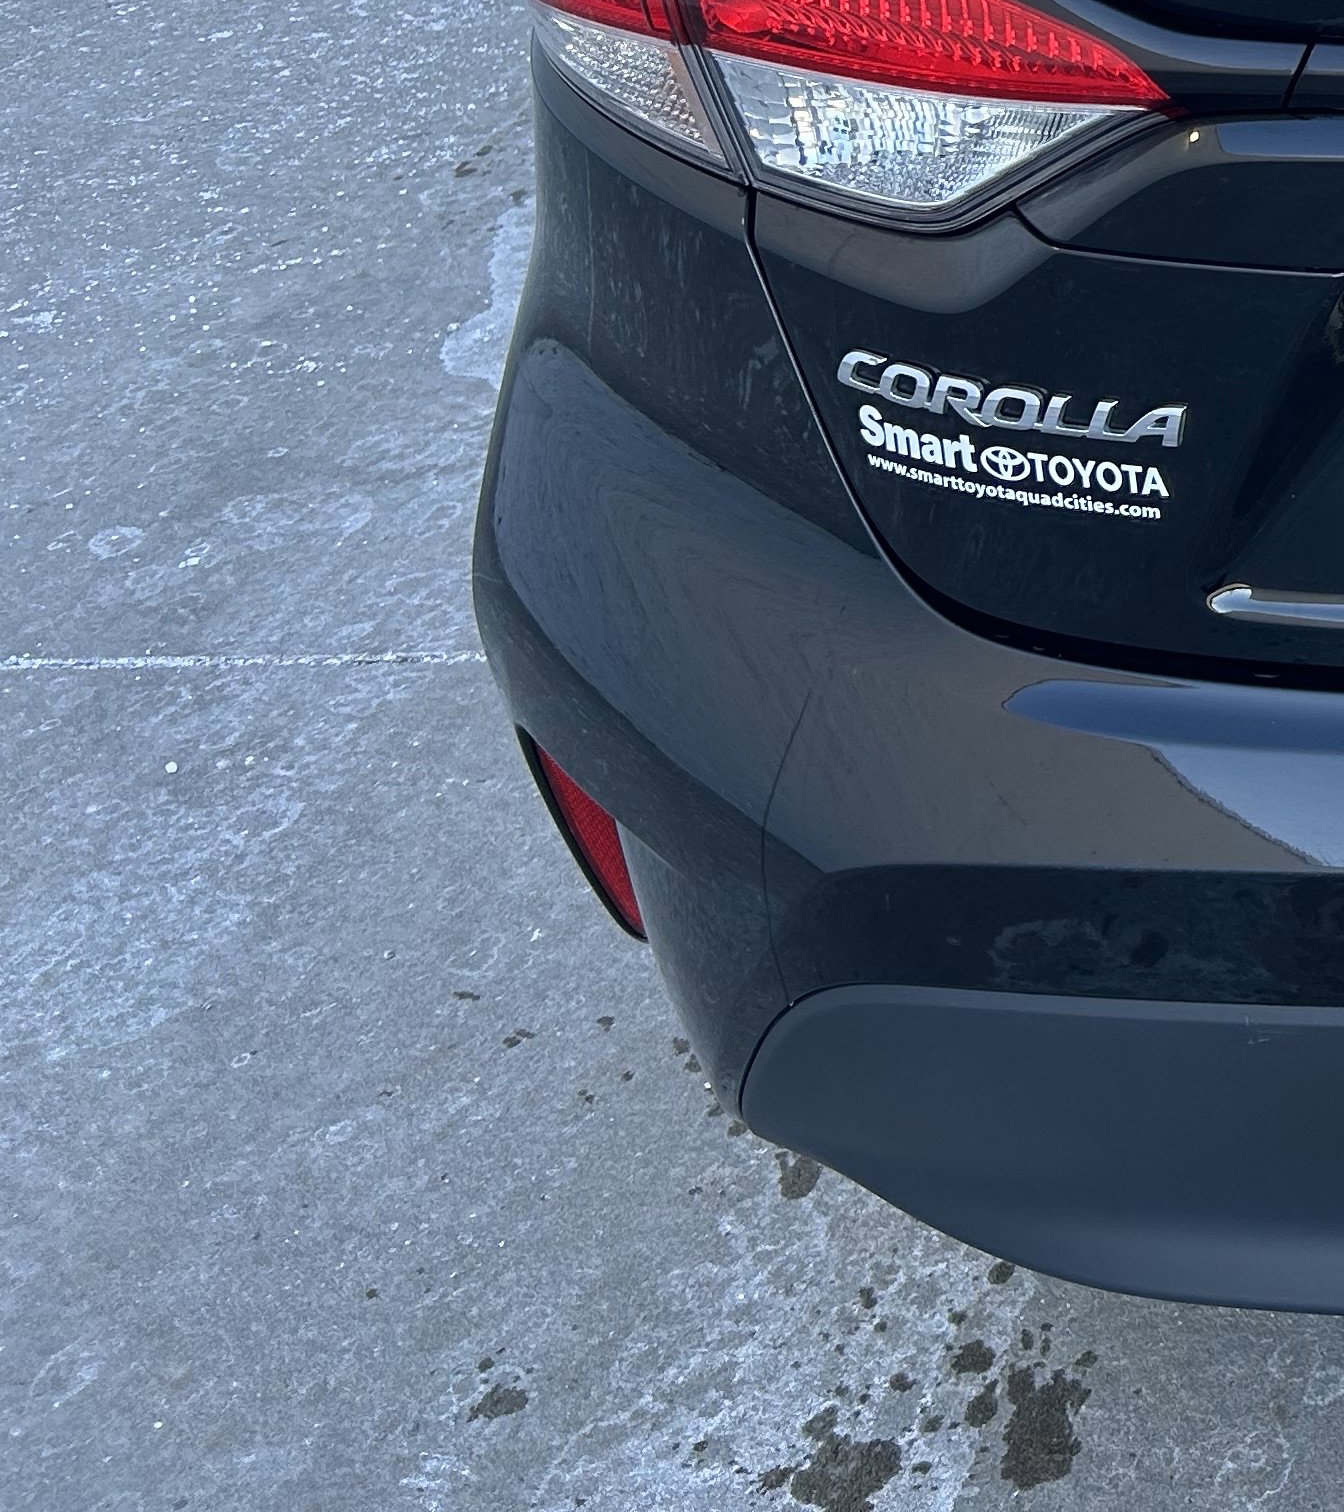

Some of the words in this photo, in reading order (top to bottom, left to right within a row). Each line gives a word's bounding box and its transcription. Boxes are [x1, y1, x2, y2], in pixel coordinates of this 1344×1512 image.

[837, 349, 1188, 448] COROLLA
[858, 404, 978, 473] Smart
[1027, 452, 1169, 498] TOYOTA
[868, 453, 1161, 520] www.smarttoyotaquadcities.com
